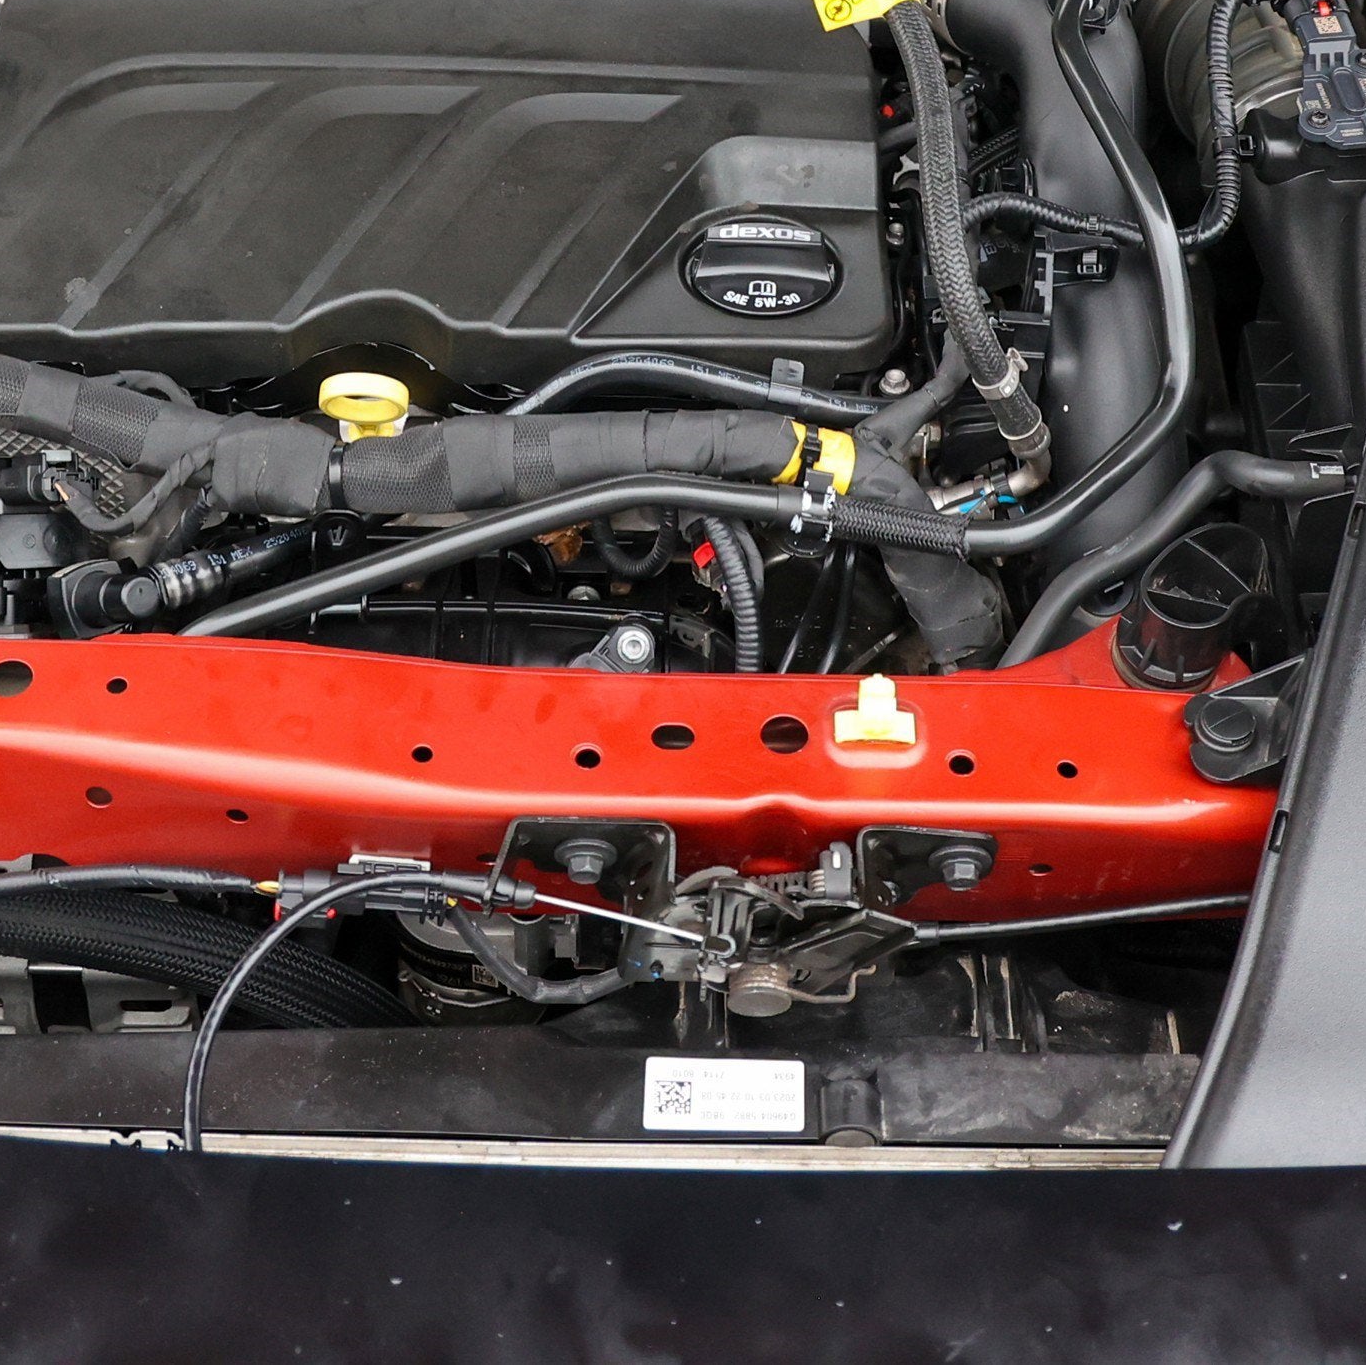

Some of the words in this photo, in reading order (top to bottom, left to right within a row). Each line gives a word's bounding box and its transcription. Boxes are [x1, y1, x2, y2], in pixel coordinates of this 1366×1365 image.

[719, 224, 812, 242] dexos
[723, 290, 750, 306] SAE
[754, 292, 801, 308] 5W-30
[229, 545, 255, 562] MEX
